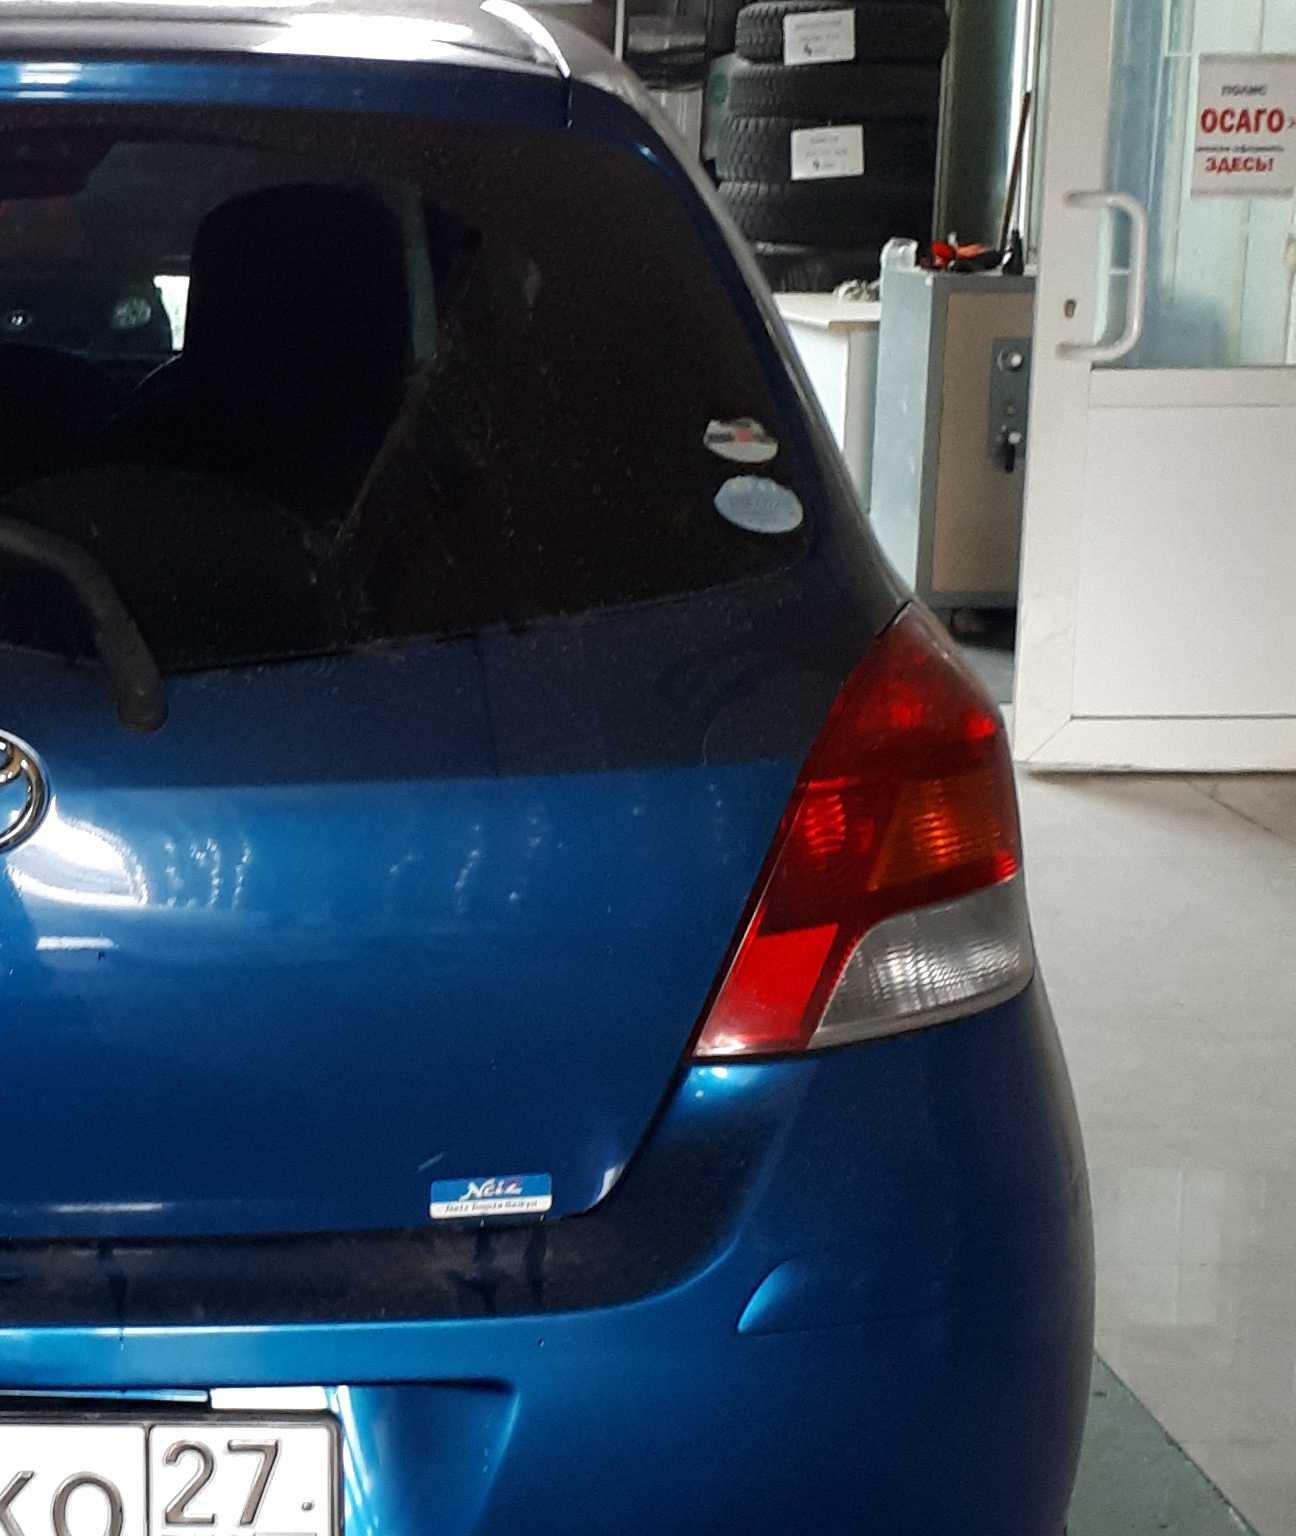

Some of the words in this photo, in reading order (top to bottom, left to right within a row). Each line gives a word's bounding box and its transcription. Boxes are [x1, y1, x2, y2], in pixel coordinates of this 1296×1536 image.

[1200, 107, 1285, 133] ОСАГО
[1205, 156, 1274, 174] ЗДЕСЬ!
[162, 1438, 281, 1526] 27
